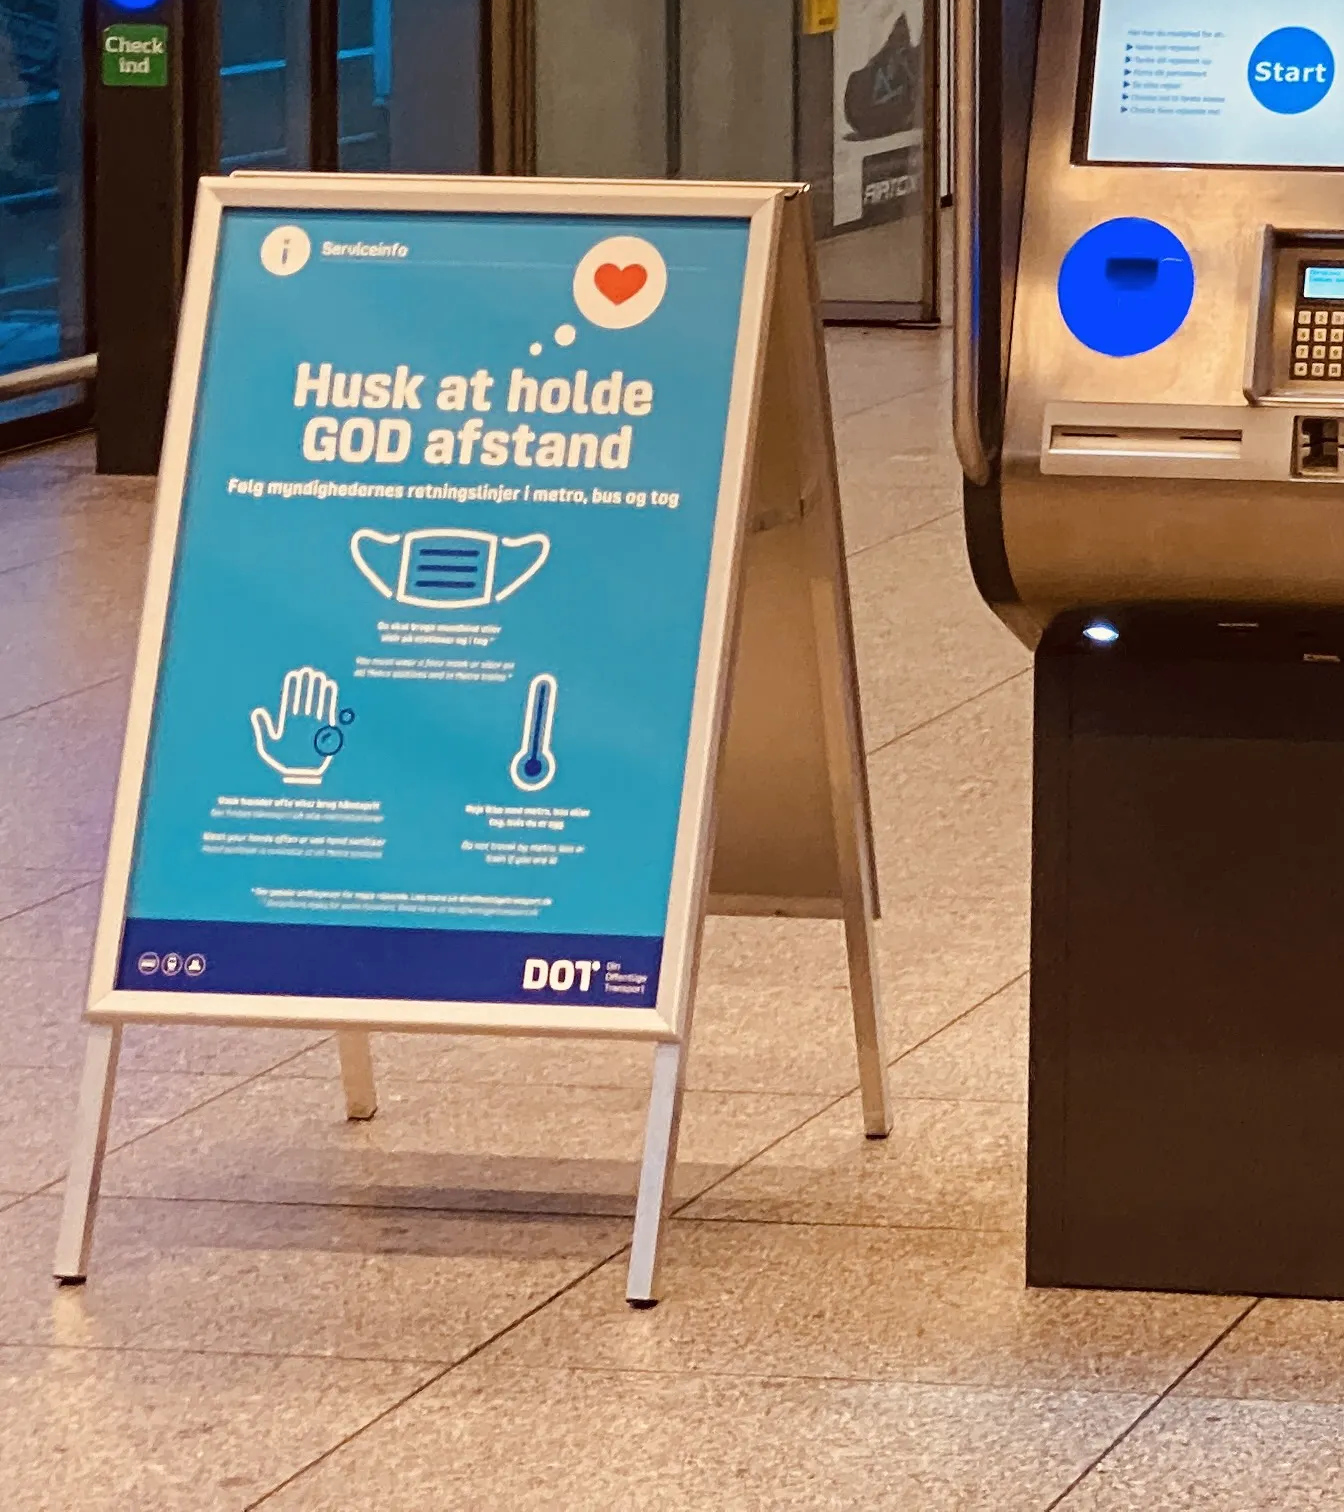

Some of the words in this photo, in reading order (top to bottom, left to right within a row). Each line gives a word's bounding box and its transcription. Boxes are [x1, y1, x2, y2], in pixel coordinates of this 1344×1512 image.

[105, 37, 164, 54] Check
[119, 57, 150, 73] ind
[1255, 61, 1327, 83] Start
[322, 240, 408, 258] Serviceinfo
[294, 363, 425, 411] Husk
[437, 368, 494, 414] at
[506, 369, 654, 416] holde
[302, 416, 411, 464] GOD
[423, 421, 632, 470] afstand
[268, 480, 403, 499] myndighedernes
[407, 483, 520, 504] retningslinjer
[524, 485, 530, 501] i
[533, 487, 588, 505] metro,
[592, 486, 621, 504] bus
[625, 491, 647, 507] og
[651, 490, 680, 508] tog
[523, 959, 600, 991] DOT
